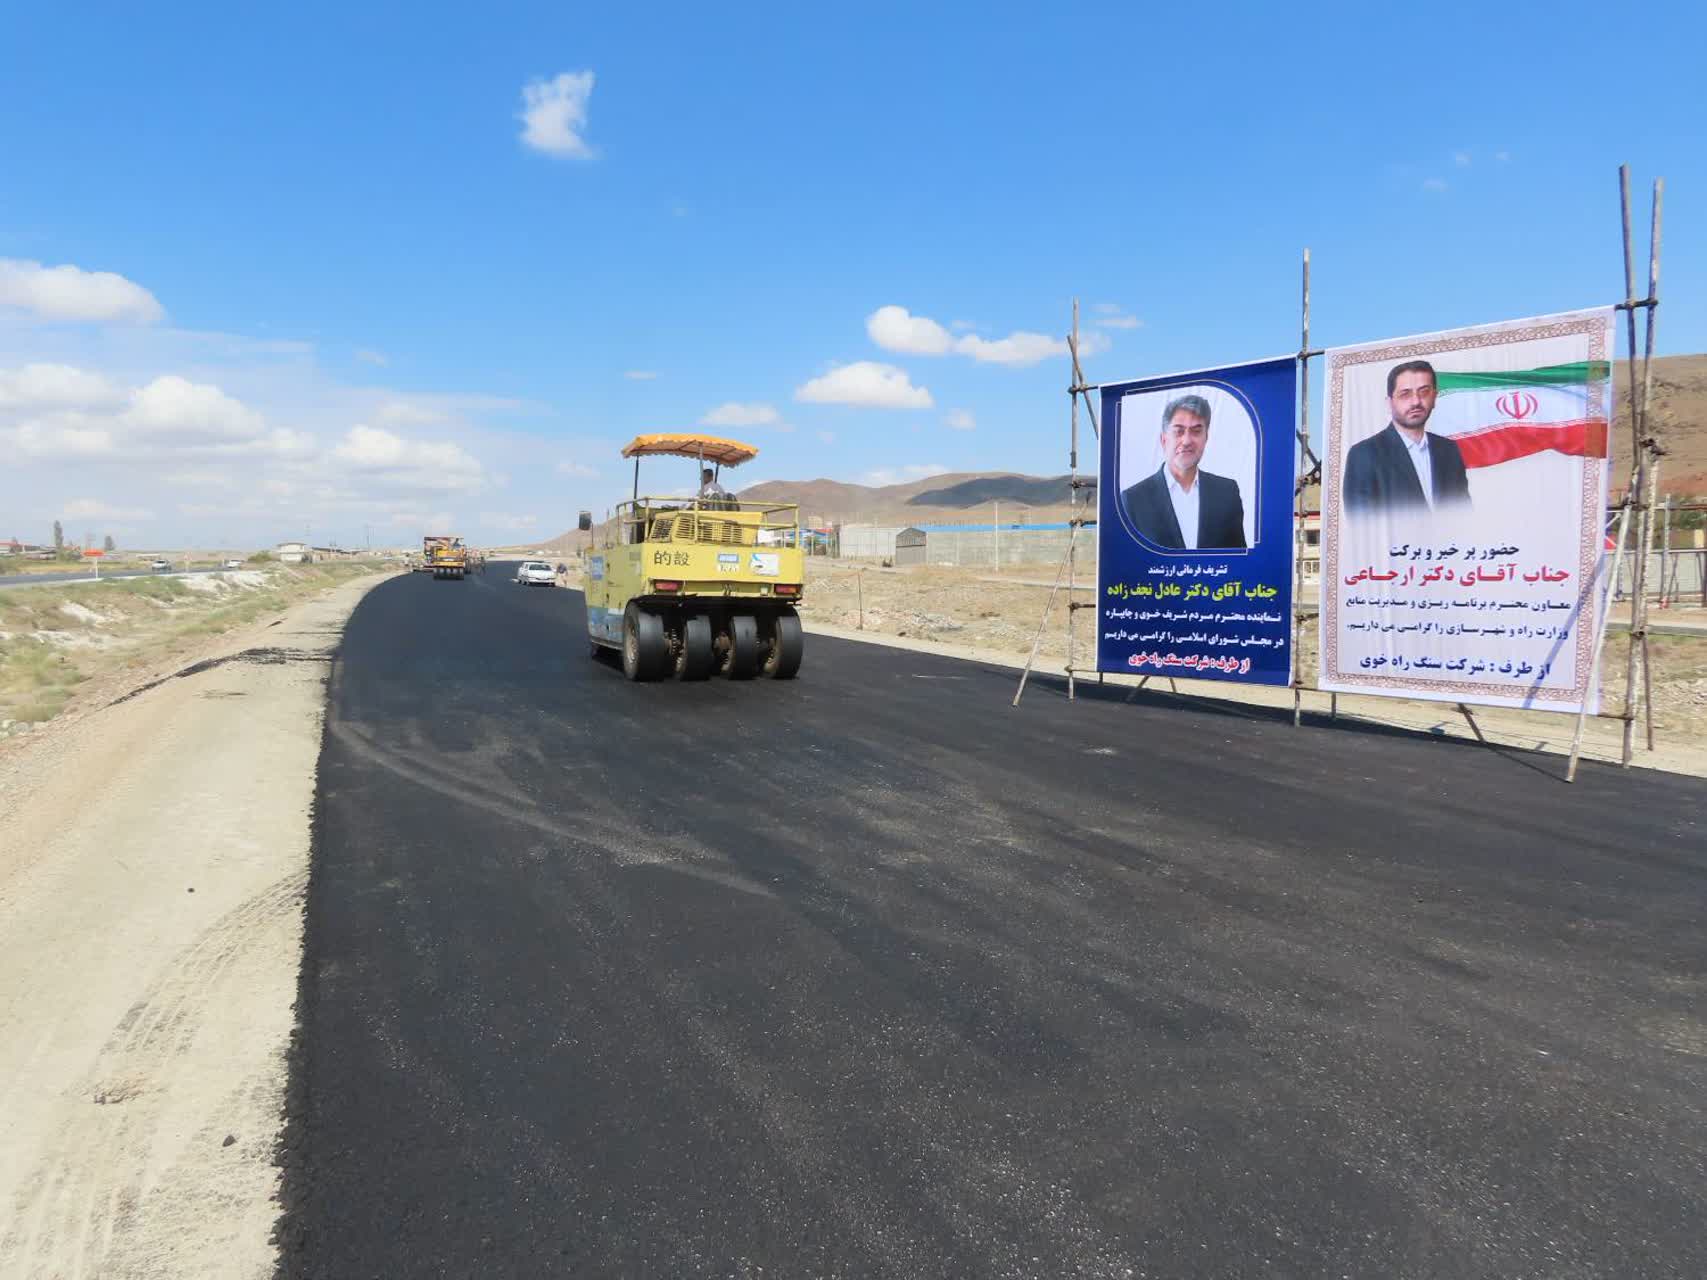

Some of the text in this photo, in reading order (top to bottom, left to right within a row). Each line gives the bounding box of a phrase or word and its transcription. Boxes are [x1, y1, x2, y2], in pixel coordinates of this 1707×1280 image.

[1389, 543, 1519, 560] حضور پر خیر و برکت
[1148, 565, 1176, 577] ارزشمند
[1203, 564, 1228, 577] تشریف
[1344, 563, 1570, 587] جناب آقای دکتر ارجاعی
[1107, 581, 1278, 601] جناب آقای دکتر عادل نجف زاده
[1346, 596, 1366, 608] منابع
[1368, 598, 1408, 608] مدیریت
[1418, 599, 1449, 609] ریزی
[1451, 598, 1486, 610] برنامه
[1489, 600, 1529, 611] محترم
[1531, 599, 1571, 611] معاون
[1139, 609, 1161, 620] خوی
[1162, 609, 1188, 621] شریف
[1189, 612, 1214, 622] مردم
[1215, 612, 1246, 623] محترم
[1246, 611, 1282, 624] نماینده
[1381, 623, 1395, 632] می
[1397, 622, 1433, 634] گرامی
[1434, 623, 1444, 635] را
[1518, 626, 1533, 638] راه
[1536, 626, 1569, 640] وزارت
[1128, 632, 1139, 641] می
[1140, 630, 1167, 642] گرامی
[1167, 631, 1174, 643] را
[1175, 632, 1207, 643] اسلامی
[1208, 633, 1240, 645] شورای
[1240, 635, 1272, 647] مجلس
[1273, 638, 1284, 648] در
[1128, 650, 1149, 667] خوی
[1148, 651, 1163, 668] راه
[1184, 654, 1211, 671] شرکت
[1216, 655, 1240, 673] طرف
[1360, 653, 1387, 668] خوی
[1392, 655, 1410, 671] راه
[1238, 657, 1251, 674] از
[1446, 658, 1485, 675] شرکت
[1499, 660, 1533, 678] طرف
[1536, 663, 1551, 680] از
